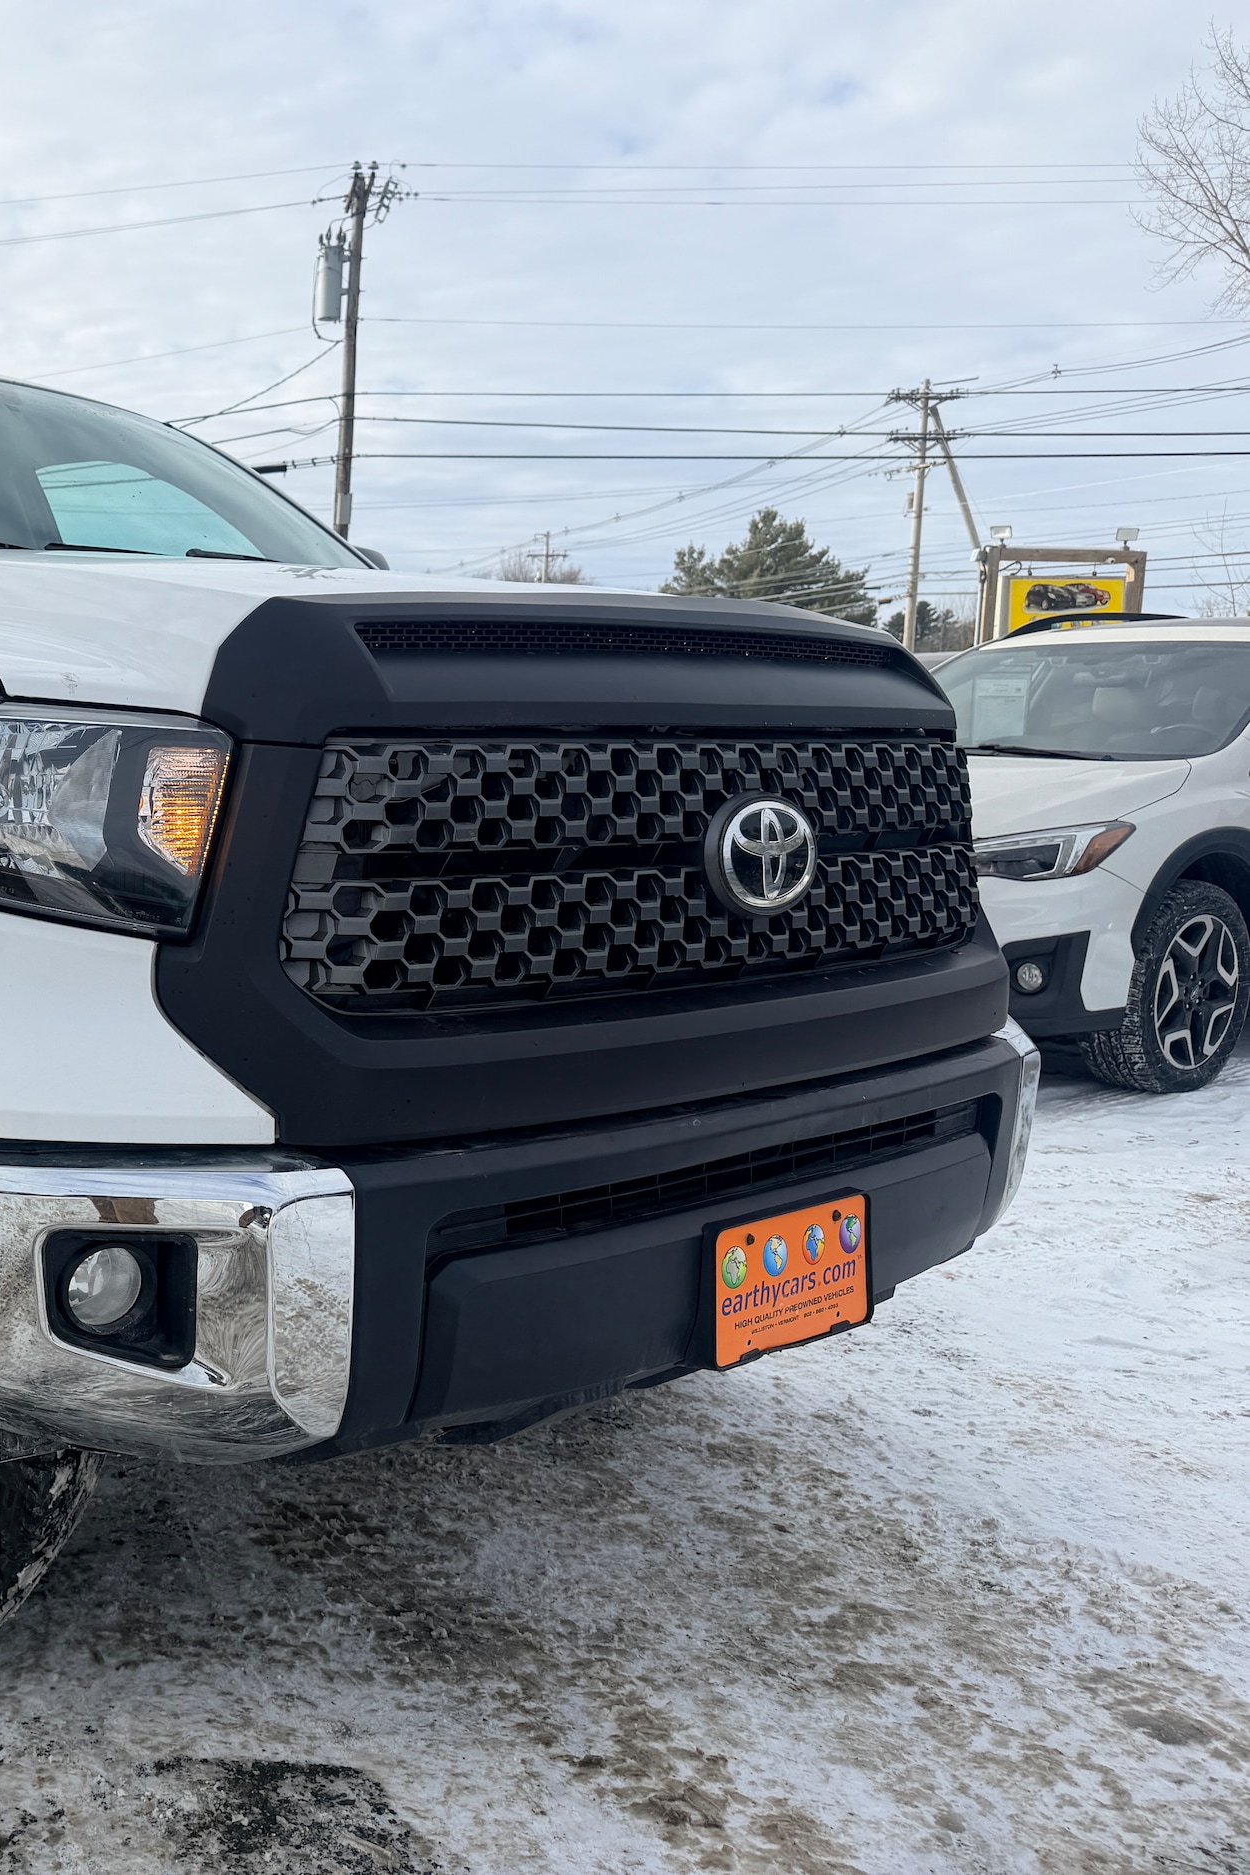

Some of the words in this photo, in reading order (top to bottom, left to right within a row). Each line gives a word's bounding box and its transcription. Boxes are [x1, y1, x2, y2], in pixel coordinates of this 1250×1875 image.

[721, 1258, 856, 1317] earthycars.com
[734, 1318, 753, 1330] HIGH
[755, 1308, 784, 1324] QUALITY
[784, 1296, 823, 1314] PREOWNED
[823, 1285, 855, 1302] VEHICLES
[778, 1315, 800, 1326] VERMONT
